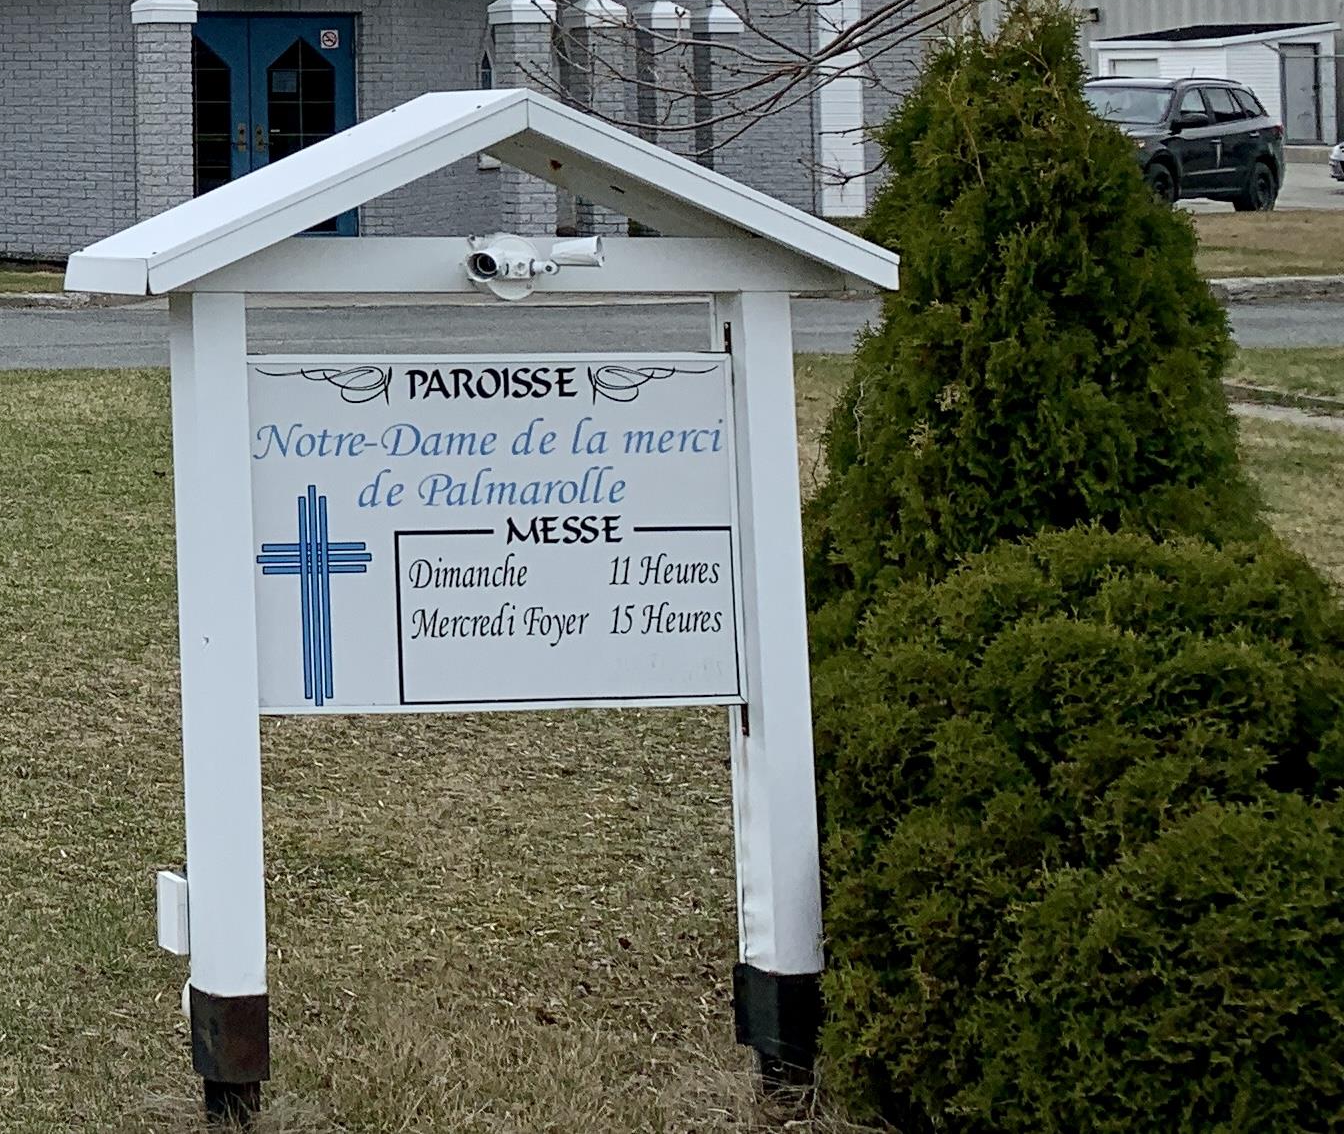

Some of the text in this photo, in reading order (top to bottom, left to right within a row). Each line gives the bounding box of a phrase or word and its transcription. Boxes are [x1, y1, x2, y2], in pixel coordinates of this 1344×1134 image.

[404, 367, 578, 400] PAROISSE
[252, 416, 724, 460] Notre-Dame de la merci
[358, 466, 626, 508] de Palmarolle
[506, 514, 624, 545] MESSE
[408, 553, 720, 589] Dimanche 11 Heures
[411, 601, 723, 647] Mercredi Foyer 15 Heures
